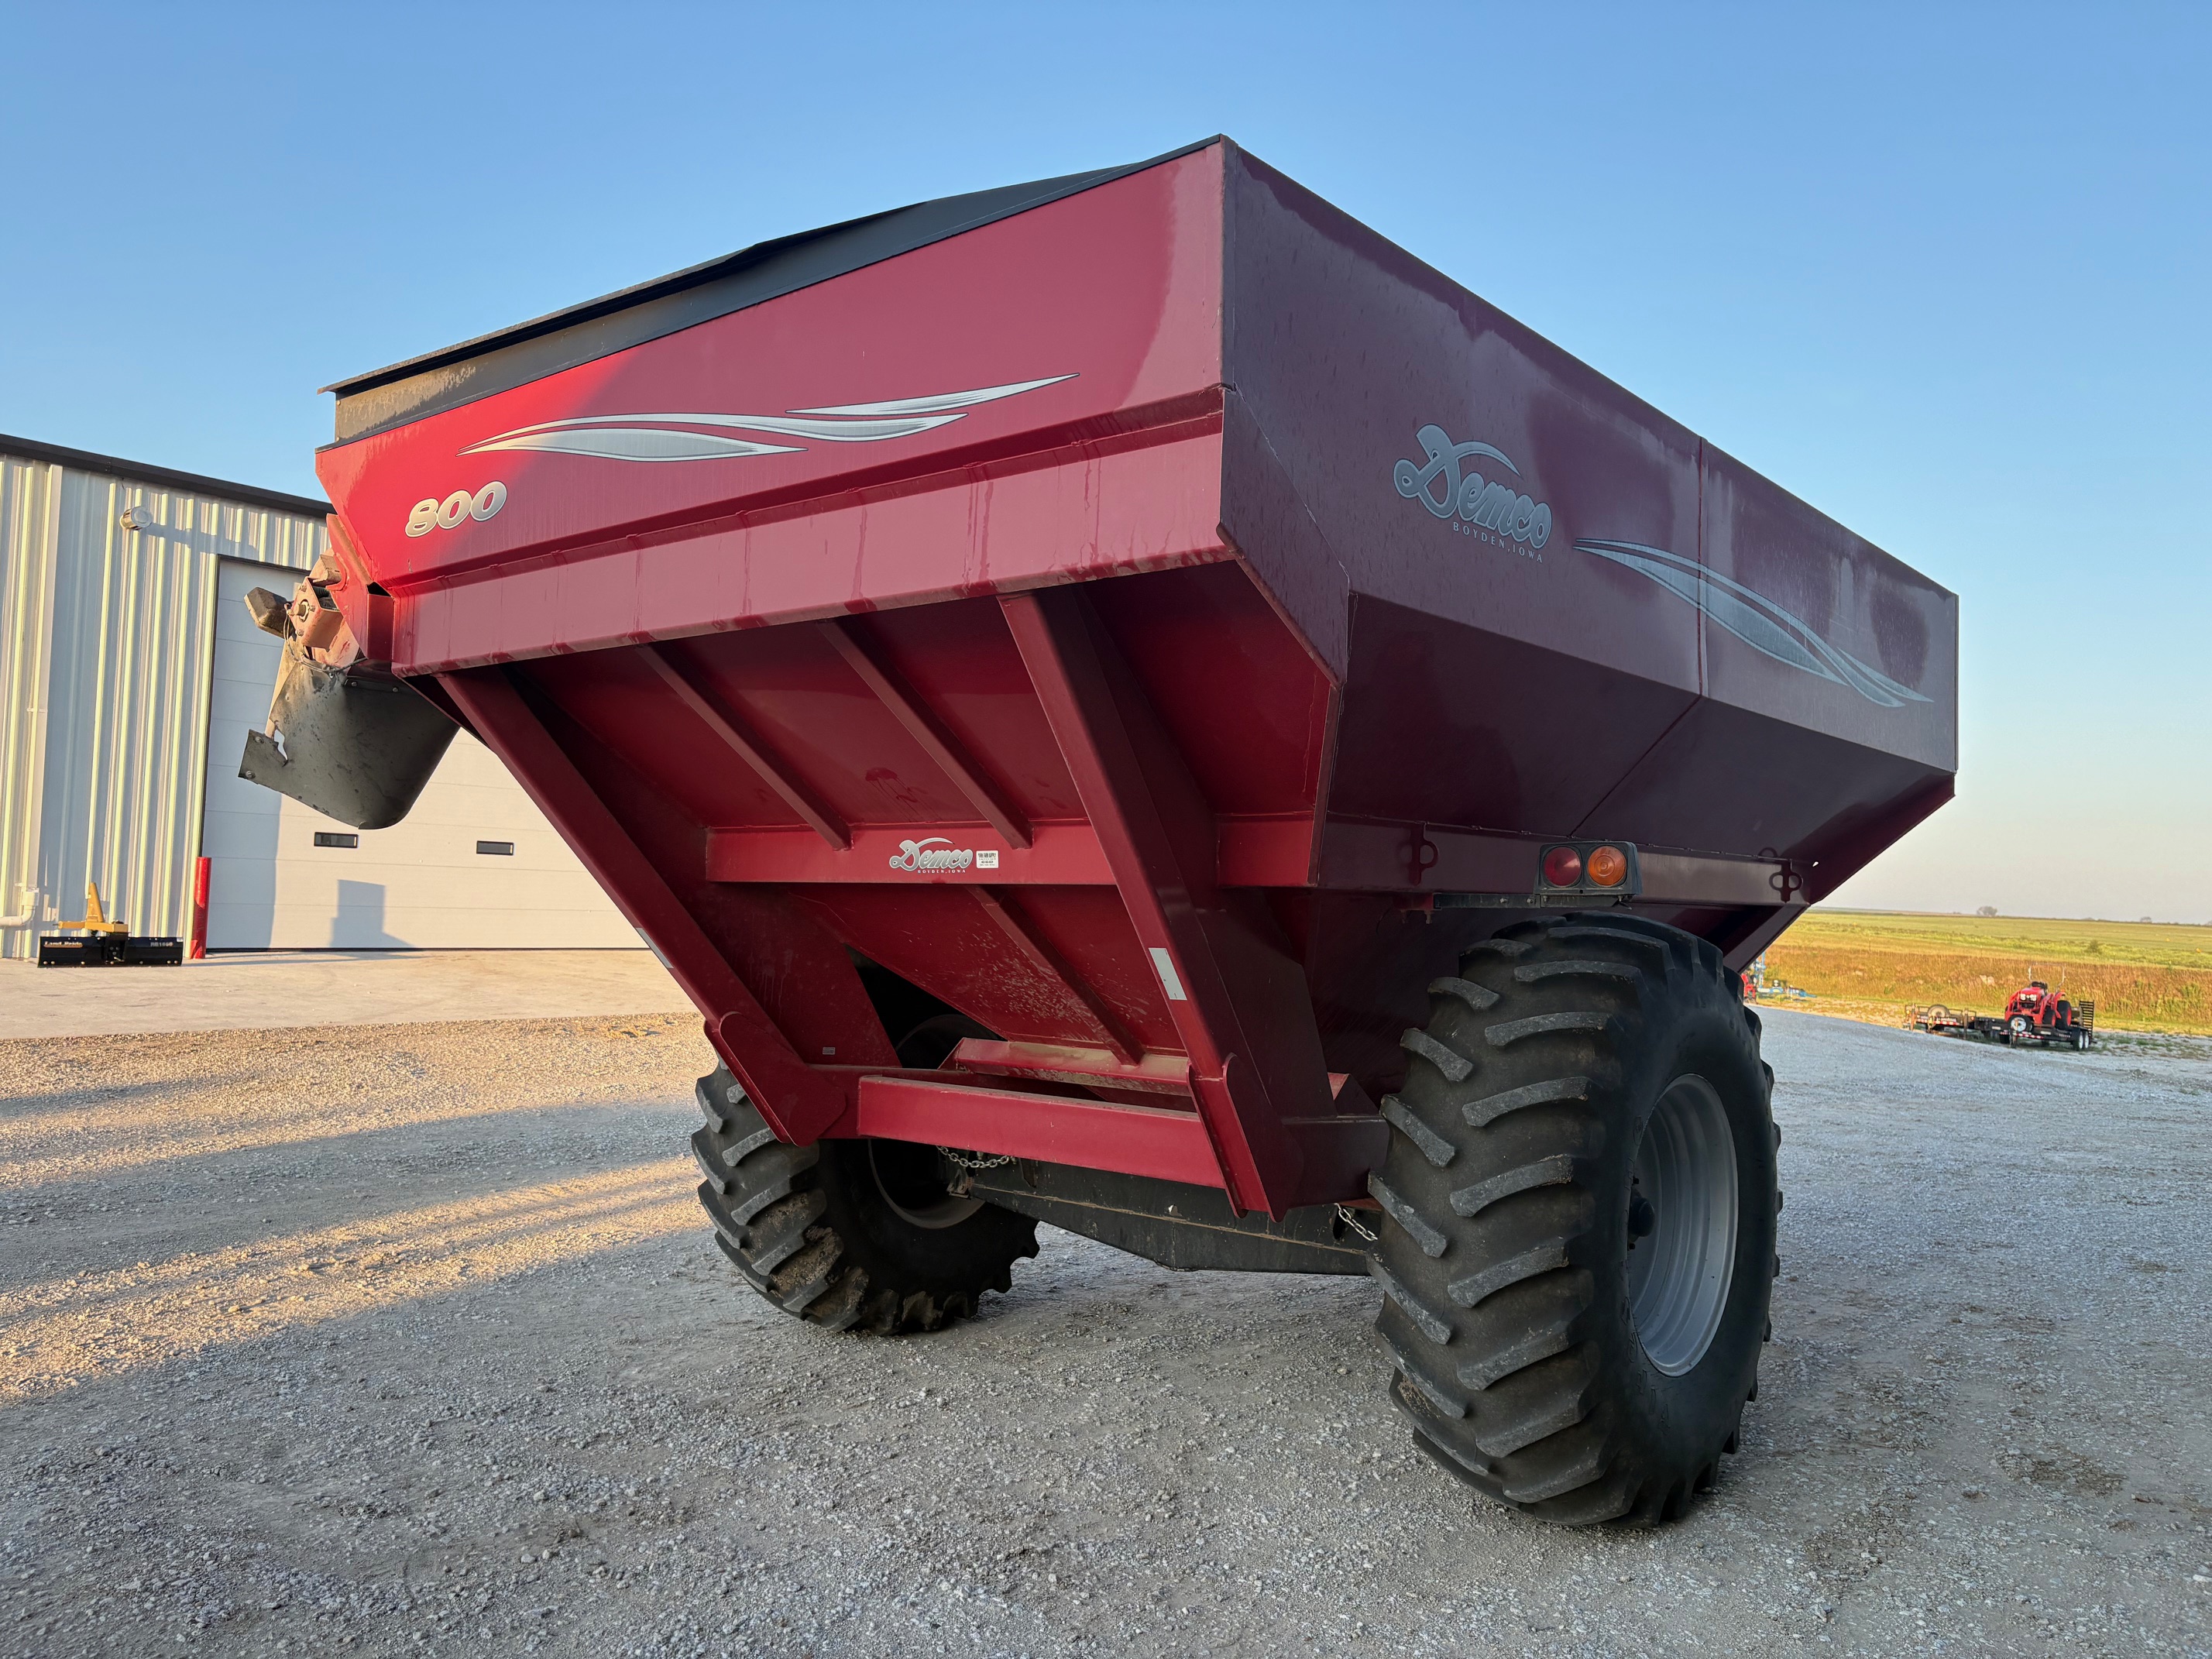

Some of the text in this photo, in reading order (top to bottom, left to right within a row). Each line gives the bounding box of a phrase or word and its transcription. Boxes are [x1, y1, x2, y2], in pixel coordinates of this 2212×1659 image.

[404, 480, 507, 538] 800
[1393, 423, 1553, 549] Demco
[889, 837, 974, 871] Demco
